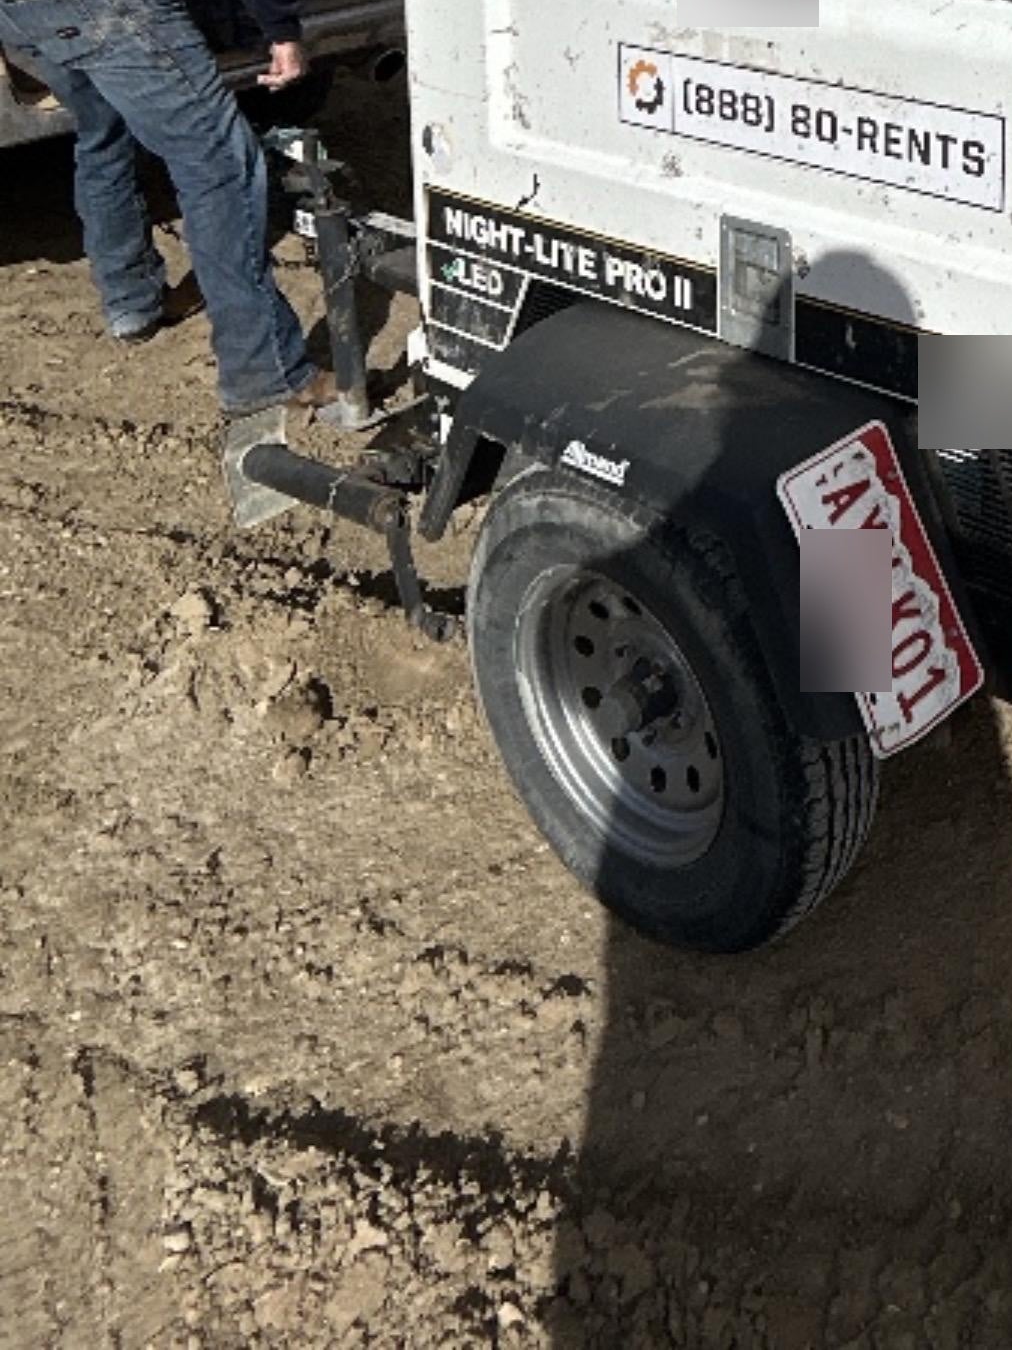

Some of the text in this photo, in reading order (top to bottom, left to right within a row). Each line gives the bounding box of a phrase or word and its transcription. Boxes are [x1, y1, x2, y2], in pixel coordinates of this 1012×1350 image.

[682, 76, 986, 178] (888) 80-RENTS
[444, 206, 692, 310] NIGHT-LITE PRO II
[456, 257, 504, 295] LED
